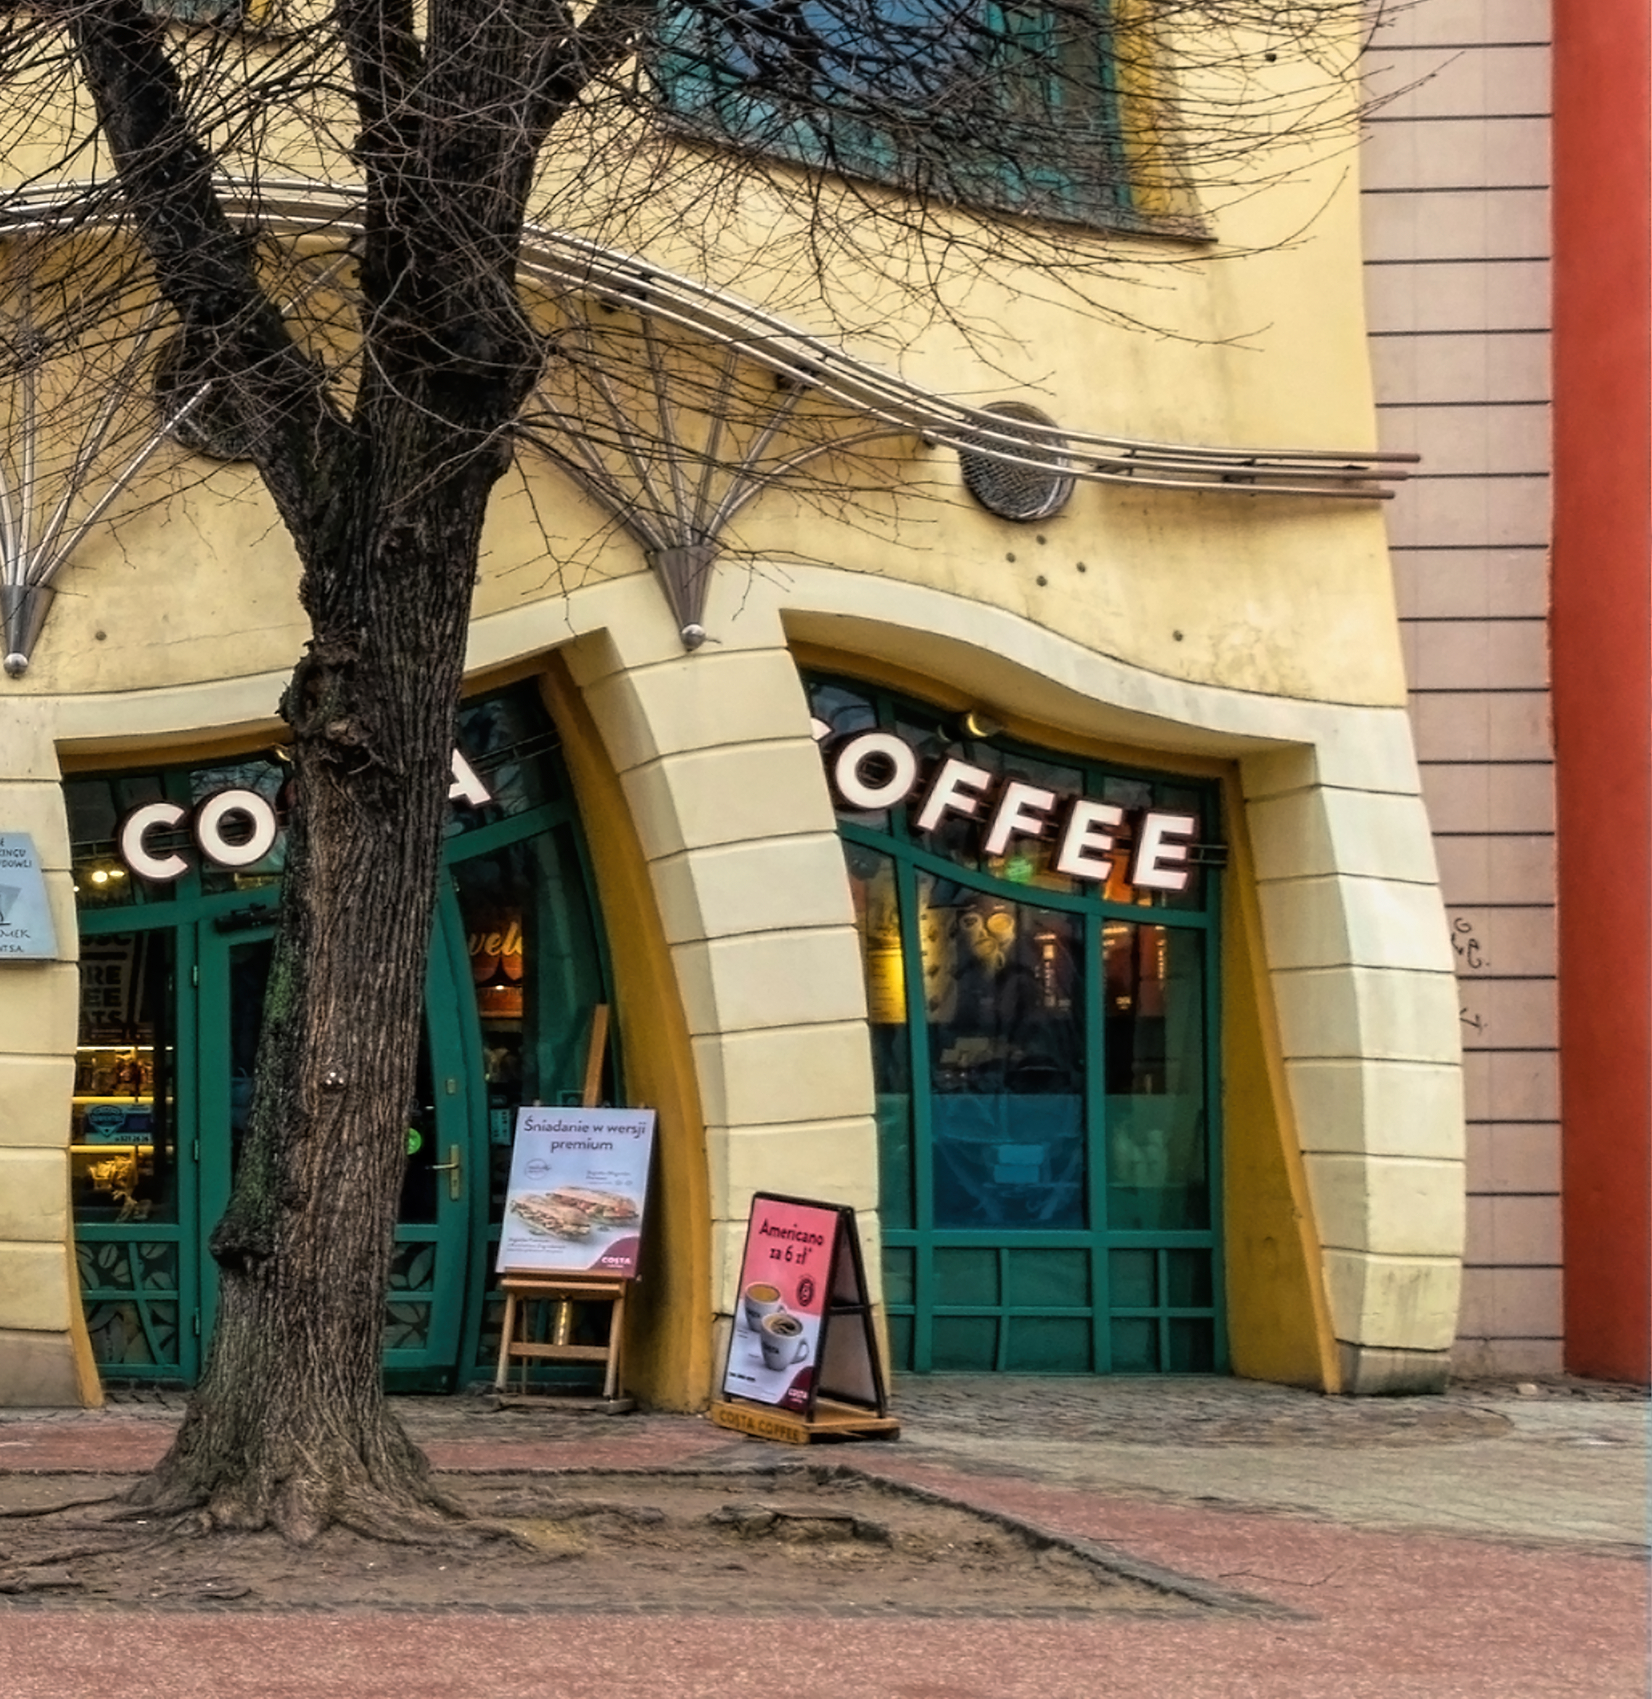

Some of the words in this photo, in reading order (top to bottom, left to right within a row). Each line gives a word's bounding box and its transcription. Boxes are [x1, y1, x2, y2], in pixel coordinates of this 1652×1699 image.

[122, 748, 491, 879] COA
[811, 716, 1194, 890] OFFEE
[524, 1115, 589, 1132] Śniadanie
[592, 1124, 604, 1132] w
[607, 1122, 647, 1139] wersji
[551, 1138, 613, 1153] premium
[759, 1218, 824, 1246] Americano
[601, 1256, 632, 1265] COSTA
[770, 1247, 782, 1261] za
[784, 1245, 793, 1262] 6
[720, 1409, 755, 1431] COSTA
[758, 1416, 800, 1443] COFFEE
